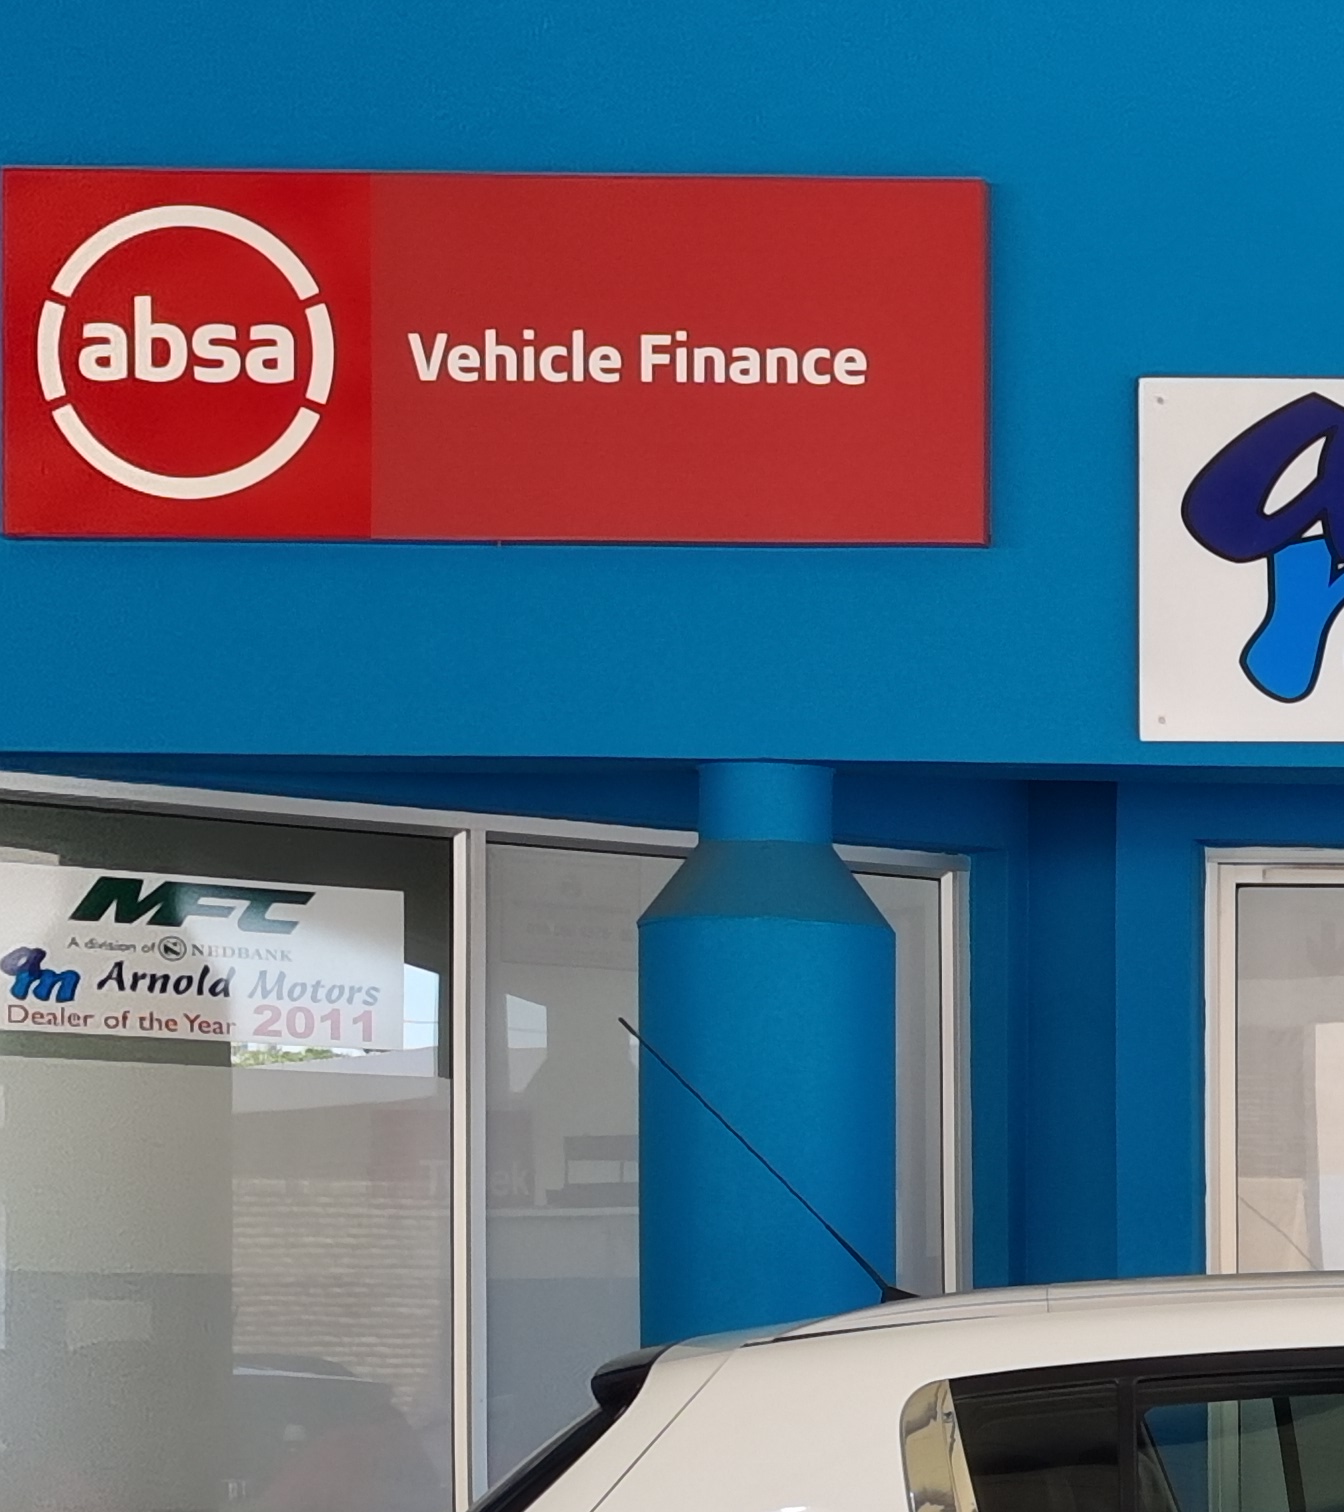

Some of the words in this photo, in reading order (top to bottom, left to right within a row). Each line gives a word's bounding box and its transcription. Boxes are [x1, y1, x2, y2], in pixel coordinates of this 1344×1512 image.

[79, 296, 295, 383] absa
[408, 329, 621, 383] Vehicle
[641, 331, 867, 384] Finance
[68, 876, 316, 935] MFC
[66, 937, 80, 949] A
[84, 936, 137, 953] division
[141, 940, 156, 954] of
[190, 943, 294, 962] NEDBANK
[97, 960, 237, 998] Arnold
[247, 970, 381, 1007] Motors
[7, 1004, 95, 1028] Dealer
[103, 1010, 131, 1030] of
[138, 1010, 179, 1033] the
[183, 1012, 238, 1035] Year
[252, 1004, 374, 1043] 2011
